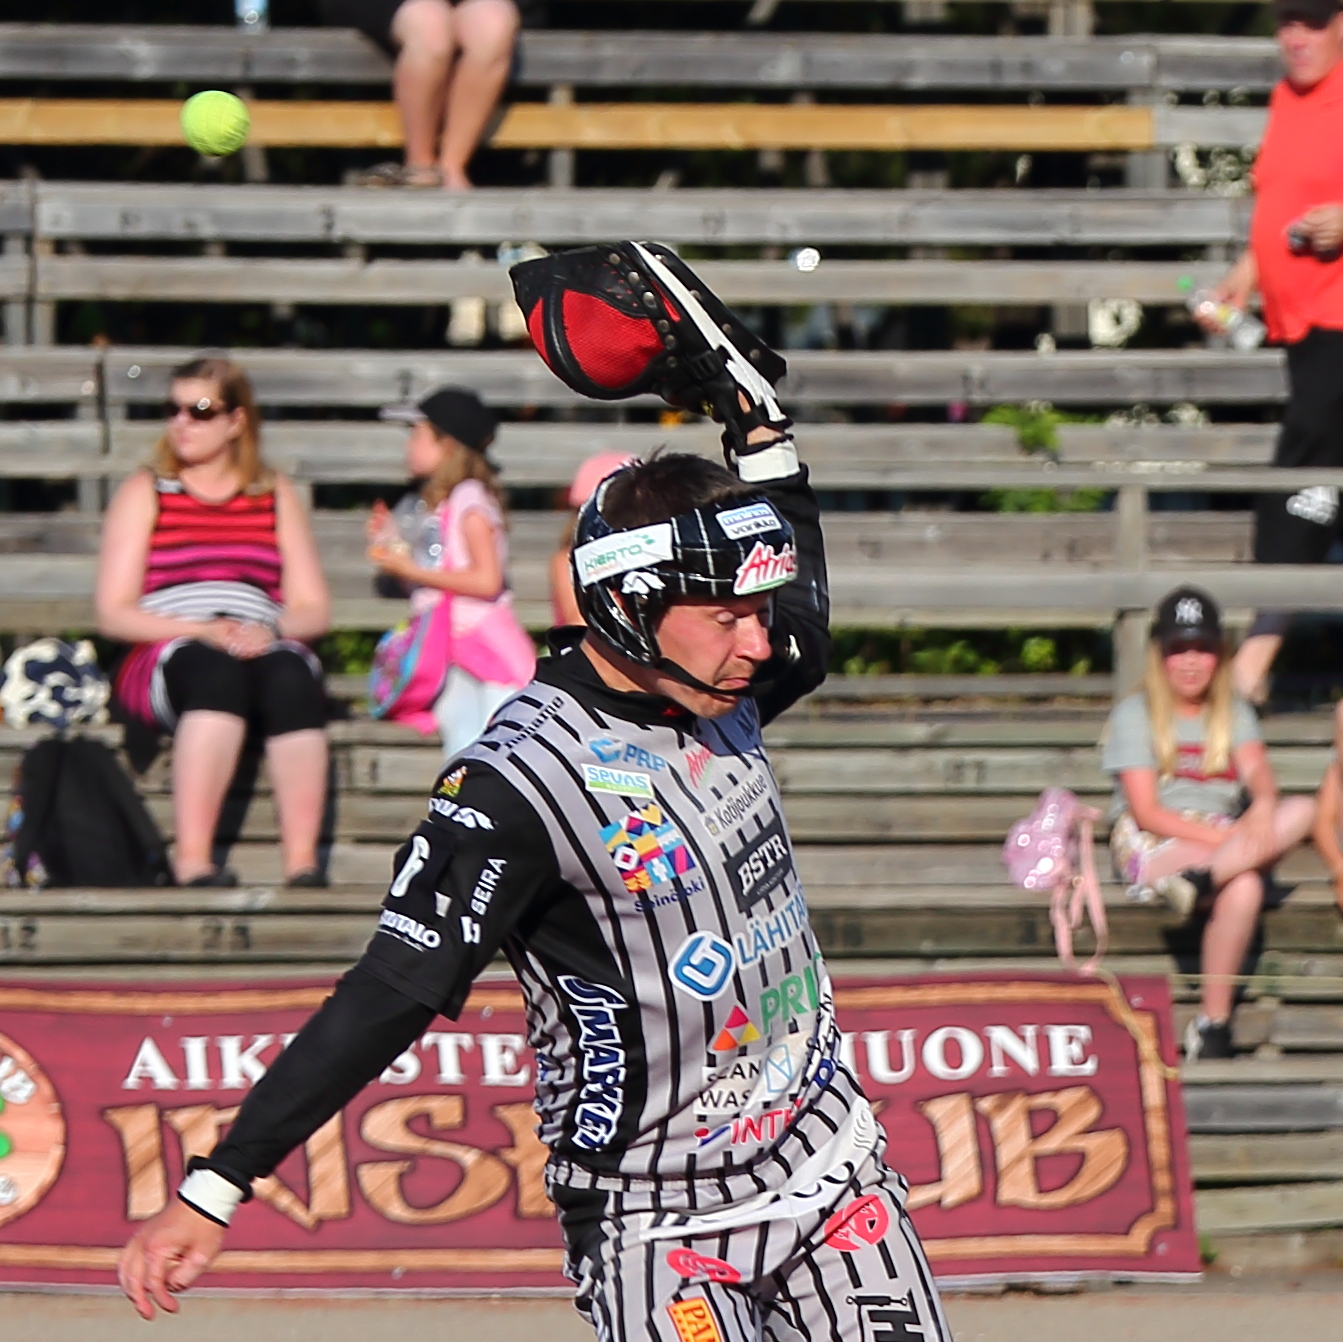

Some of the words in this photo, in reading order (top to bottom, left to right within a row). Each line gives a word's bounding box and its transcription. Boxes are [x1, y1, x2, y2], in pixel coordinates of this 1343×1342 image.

[624, 743, 668, 773] PRP
[715, 773, 768, 832] Kotijoukkue
[738, 833, 788, 896] BSTR
[736, 885, 808, 964] LÄHITA
